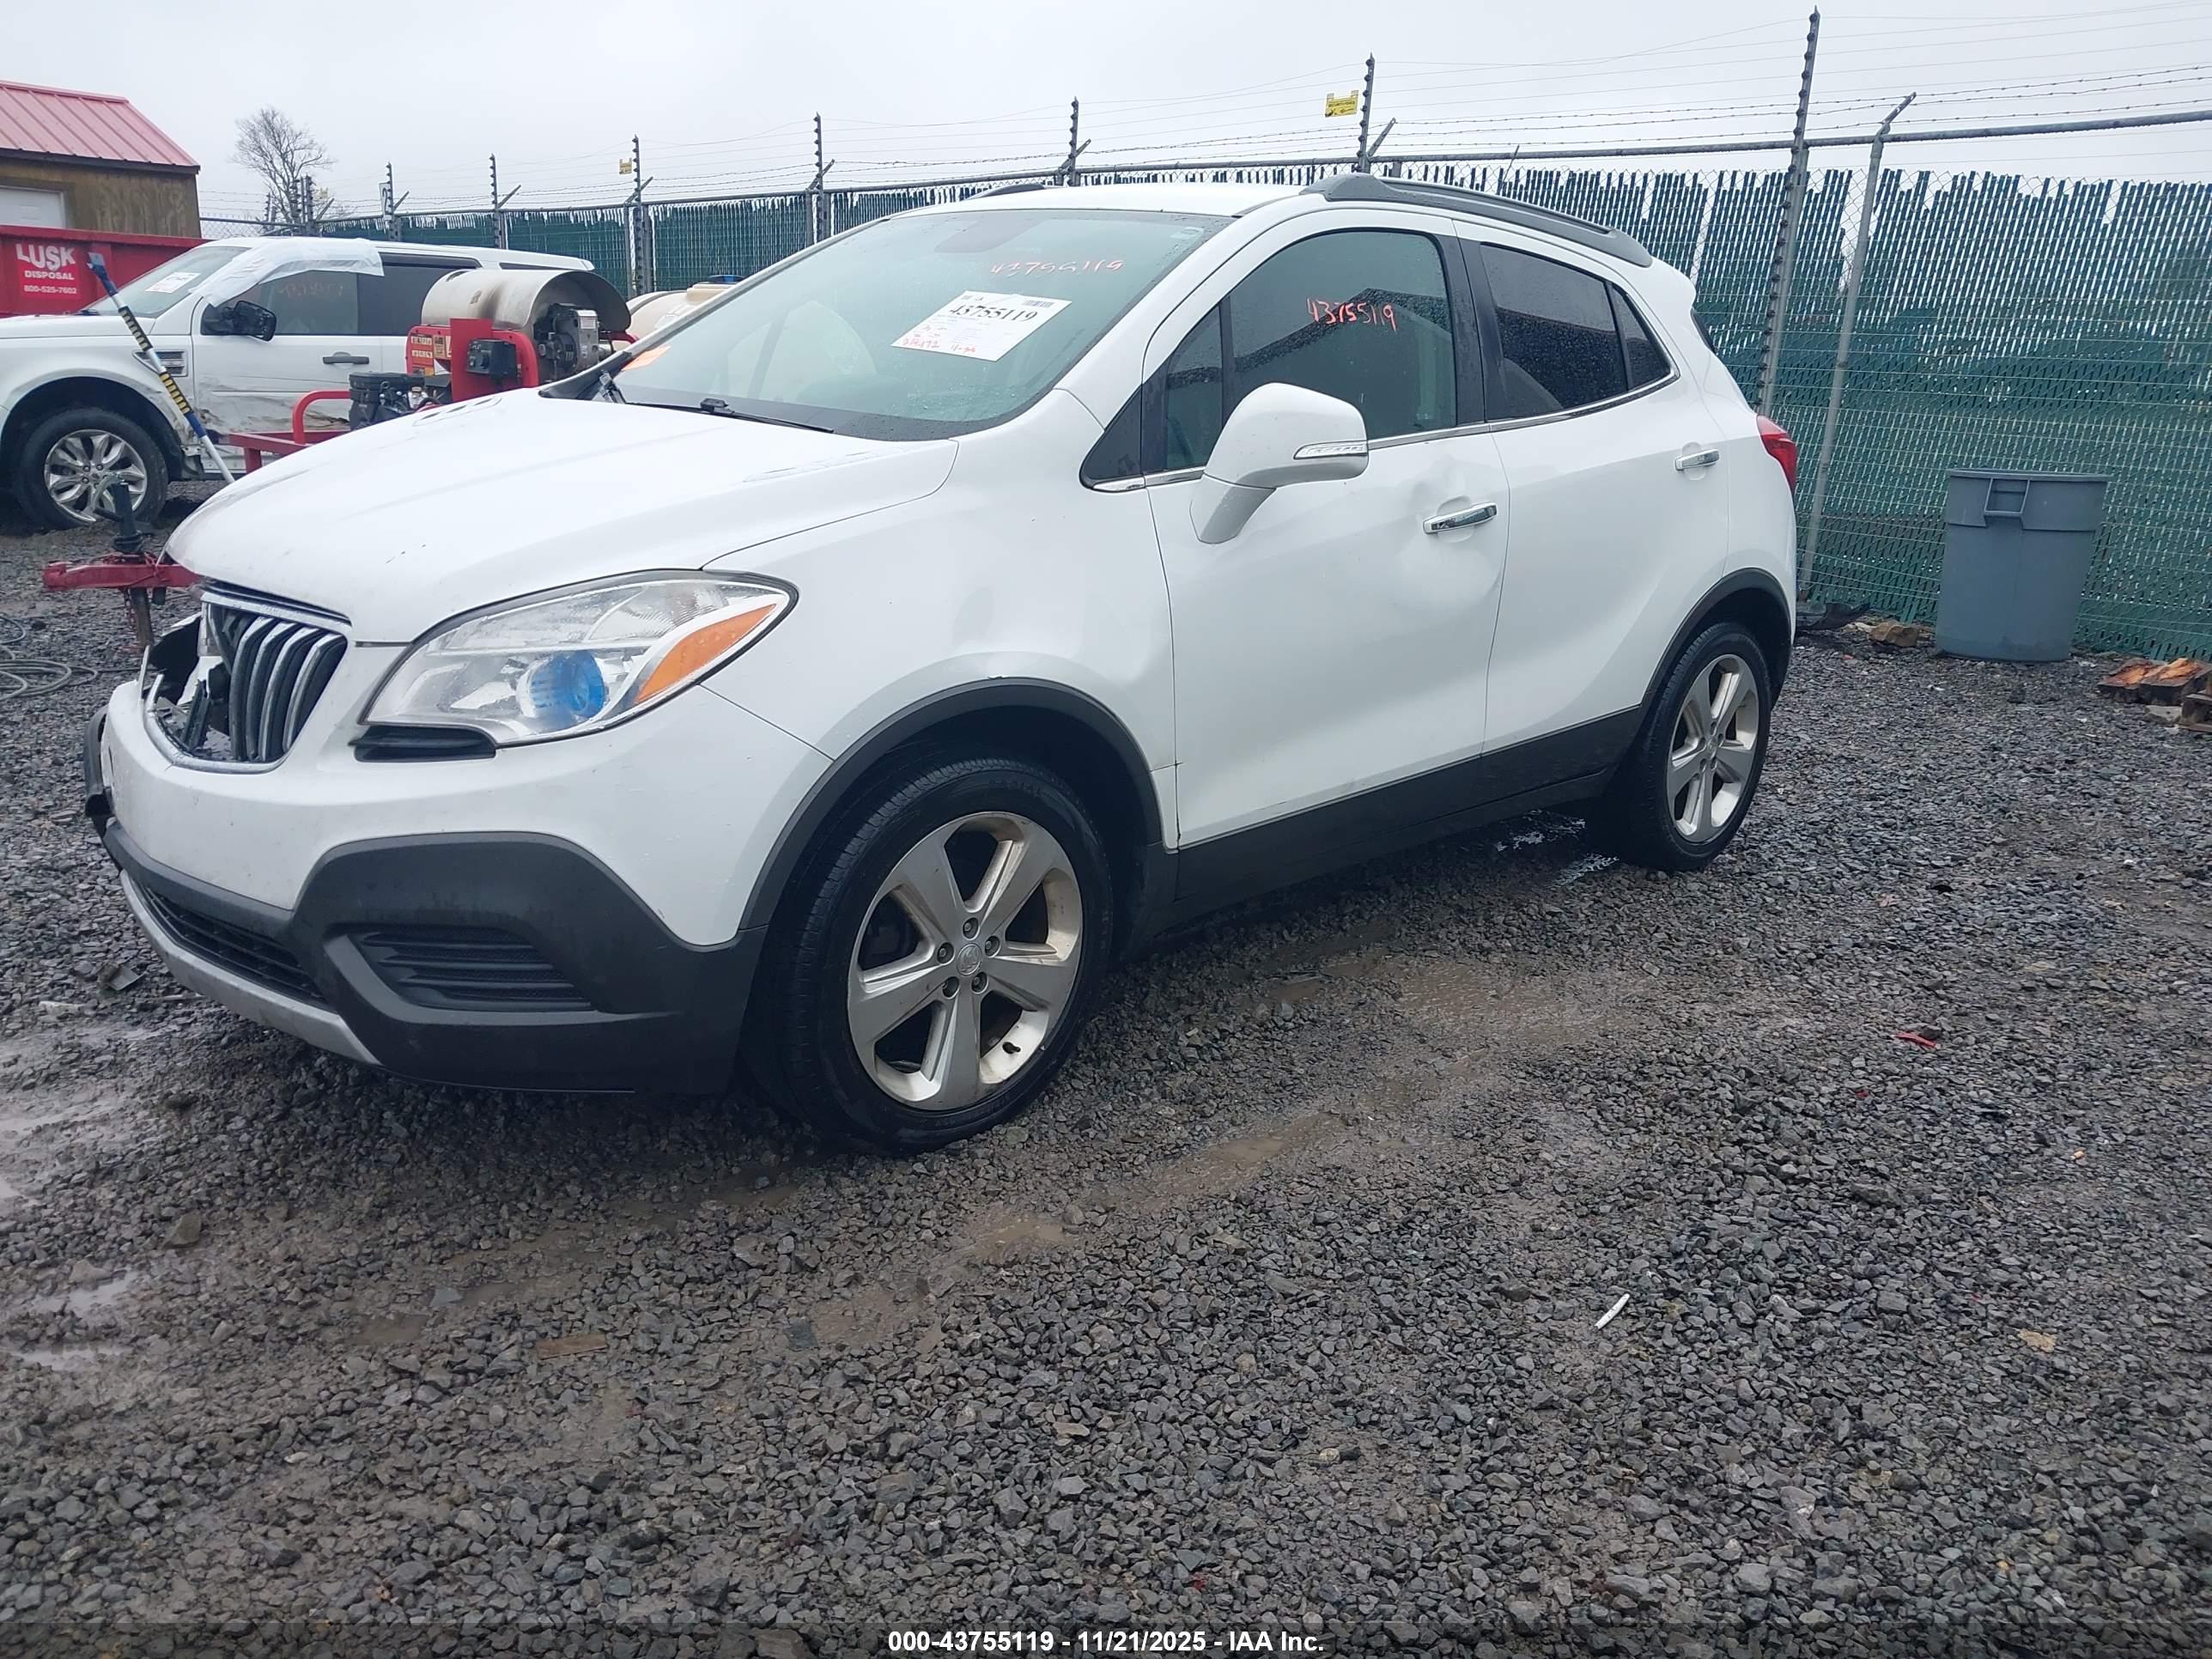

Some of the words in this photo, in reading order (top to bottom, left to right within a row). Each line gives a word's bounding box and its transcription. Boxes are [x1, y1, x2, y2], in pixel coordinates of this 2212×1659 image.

[15, 243, 76, 271] LUSK
[24, 270, 75, 281] DISPOSAL
[950, 304, 1038, 322] 43755119
